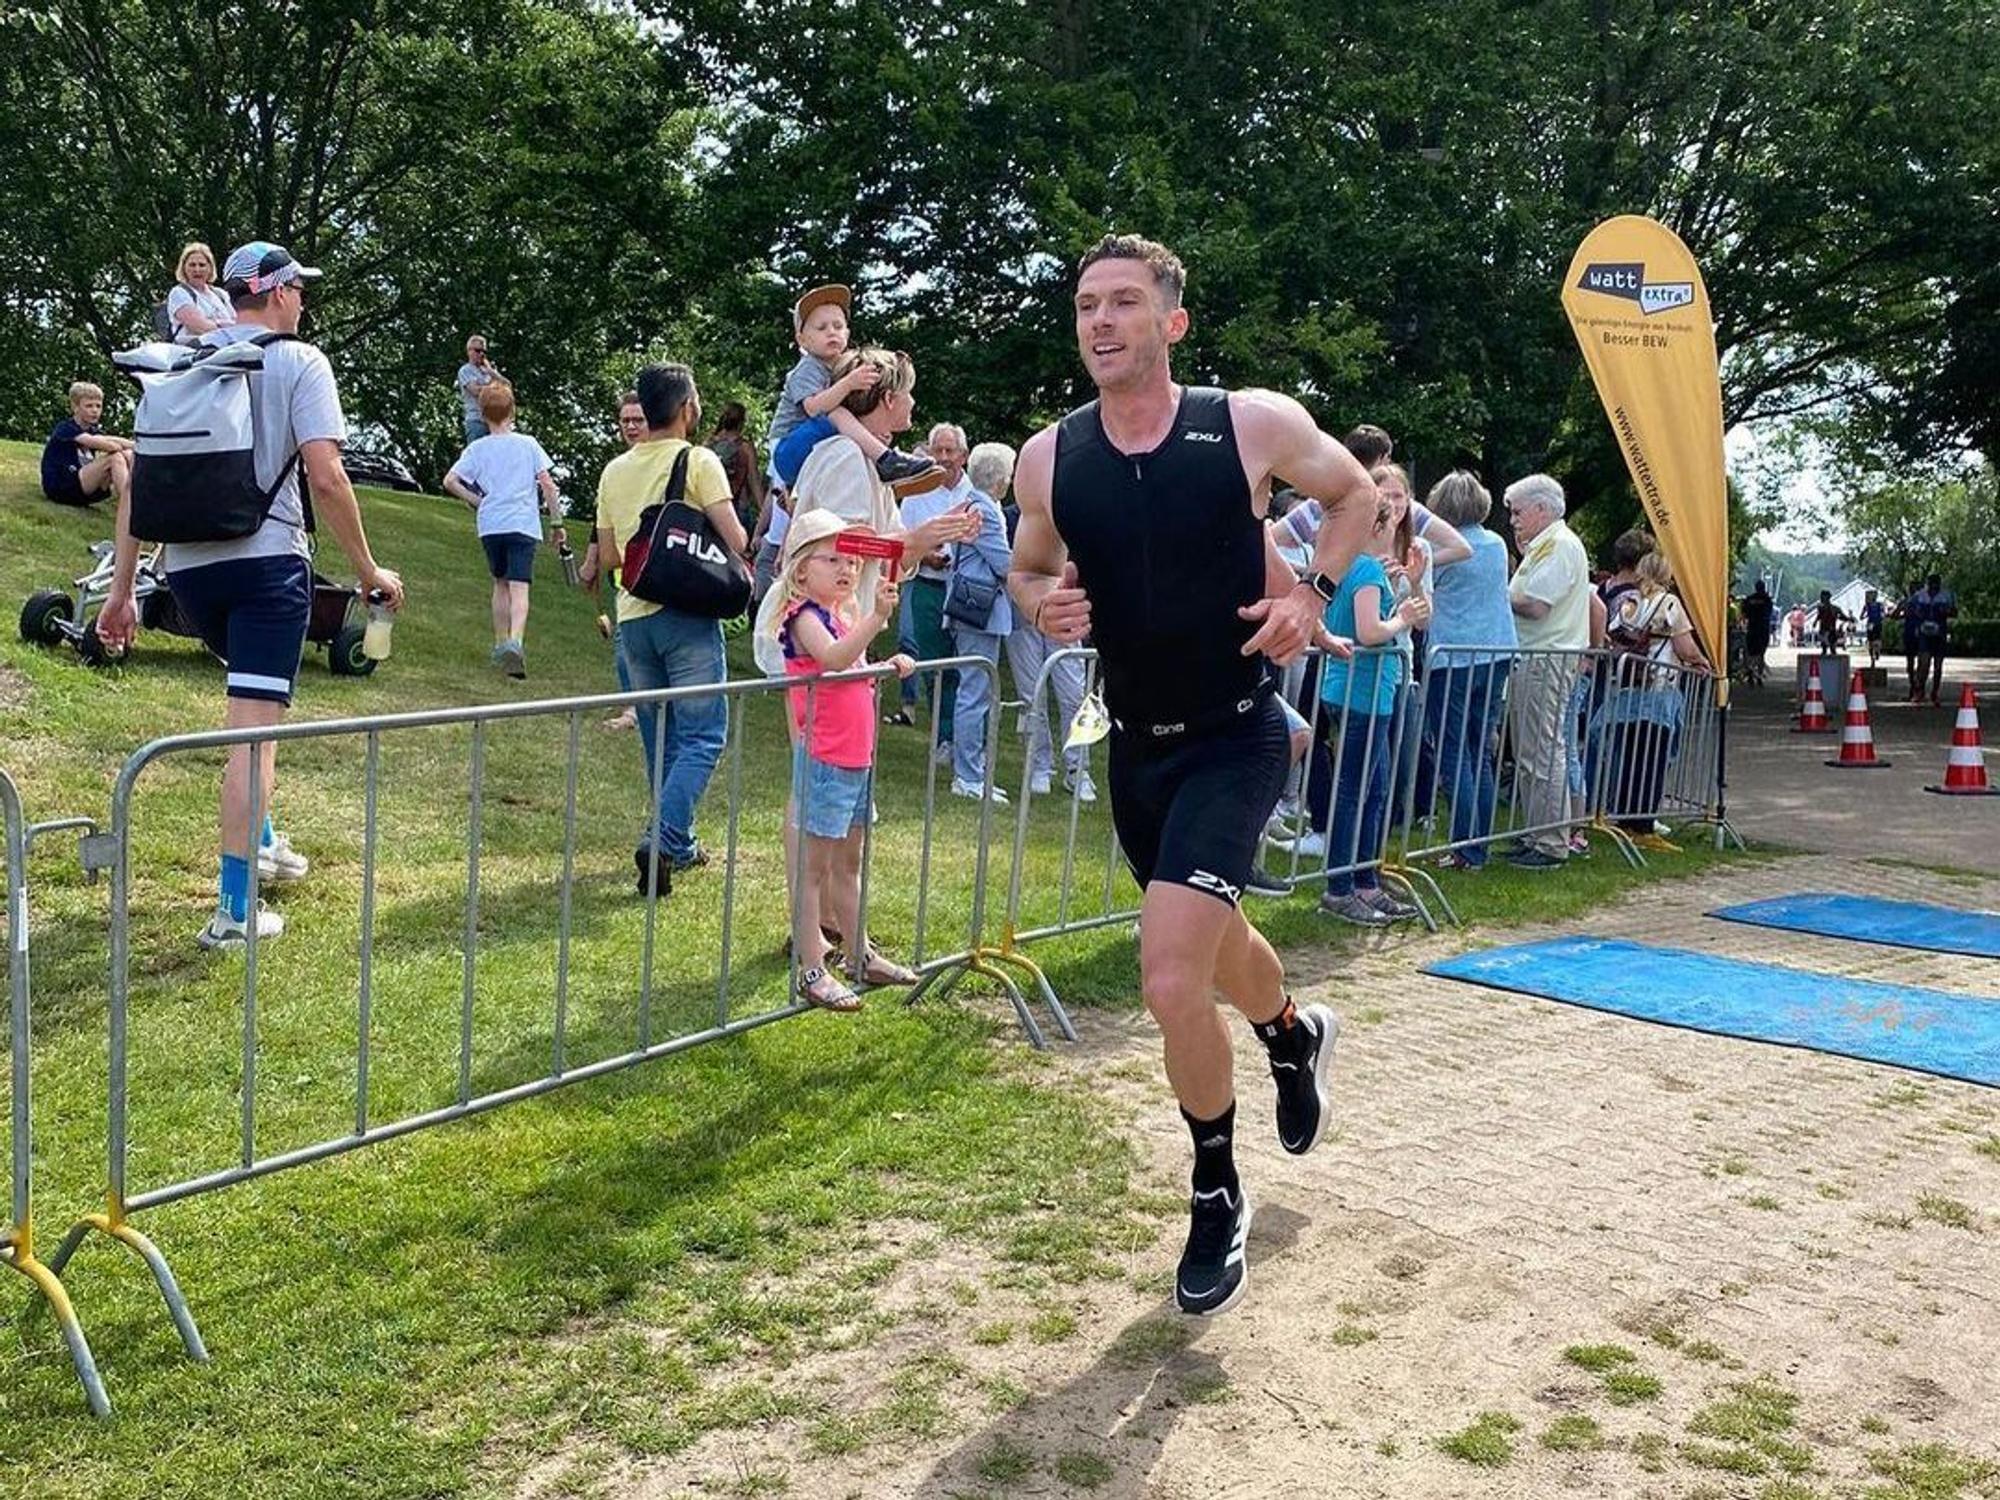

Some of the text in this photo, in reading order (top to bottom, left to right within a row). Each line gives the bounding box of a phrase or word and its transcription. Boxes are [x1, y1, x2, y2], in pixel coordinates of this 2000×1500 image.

[1590, 271, 1637, 289] watt
[1603, 332, 1668, 348] Besser BEW
[1184, 431, 1223, 443] 2XU
[1615, 407, 1670, 527] www.wattextra.de
[666, 527, 728, 565] FILA
